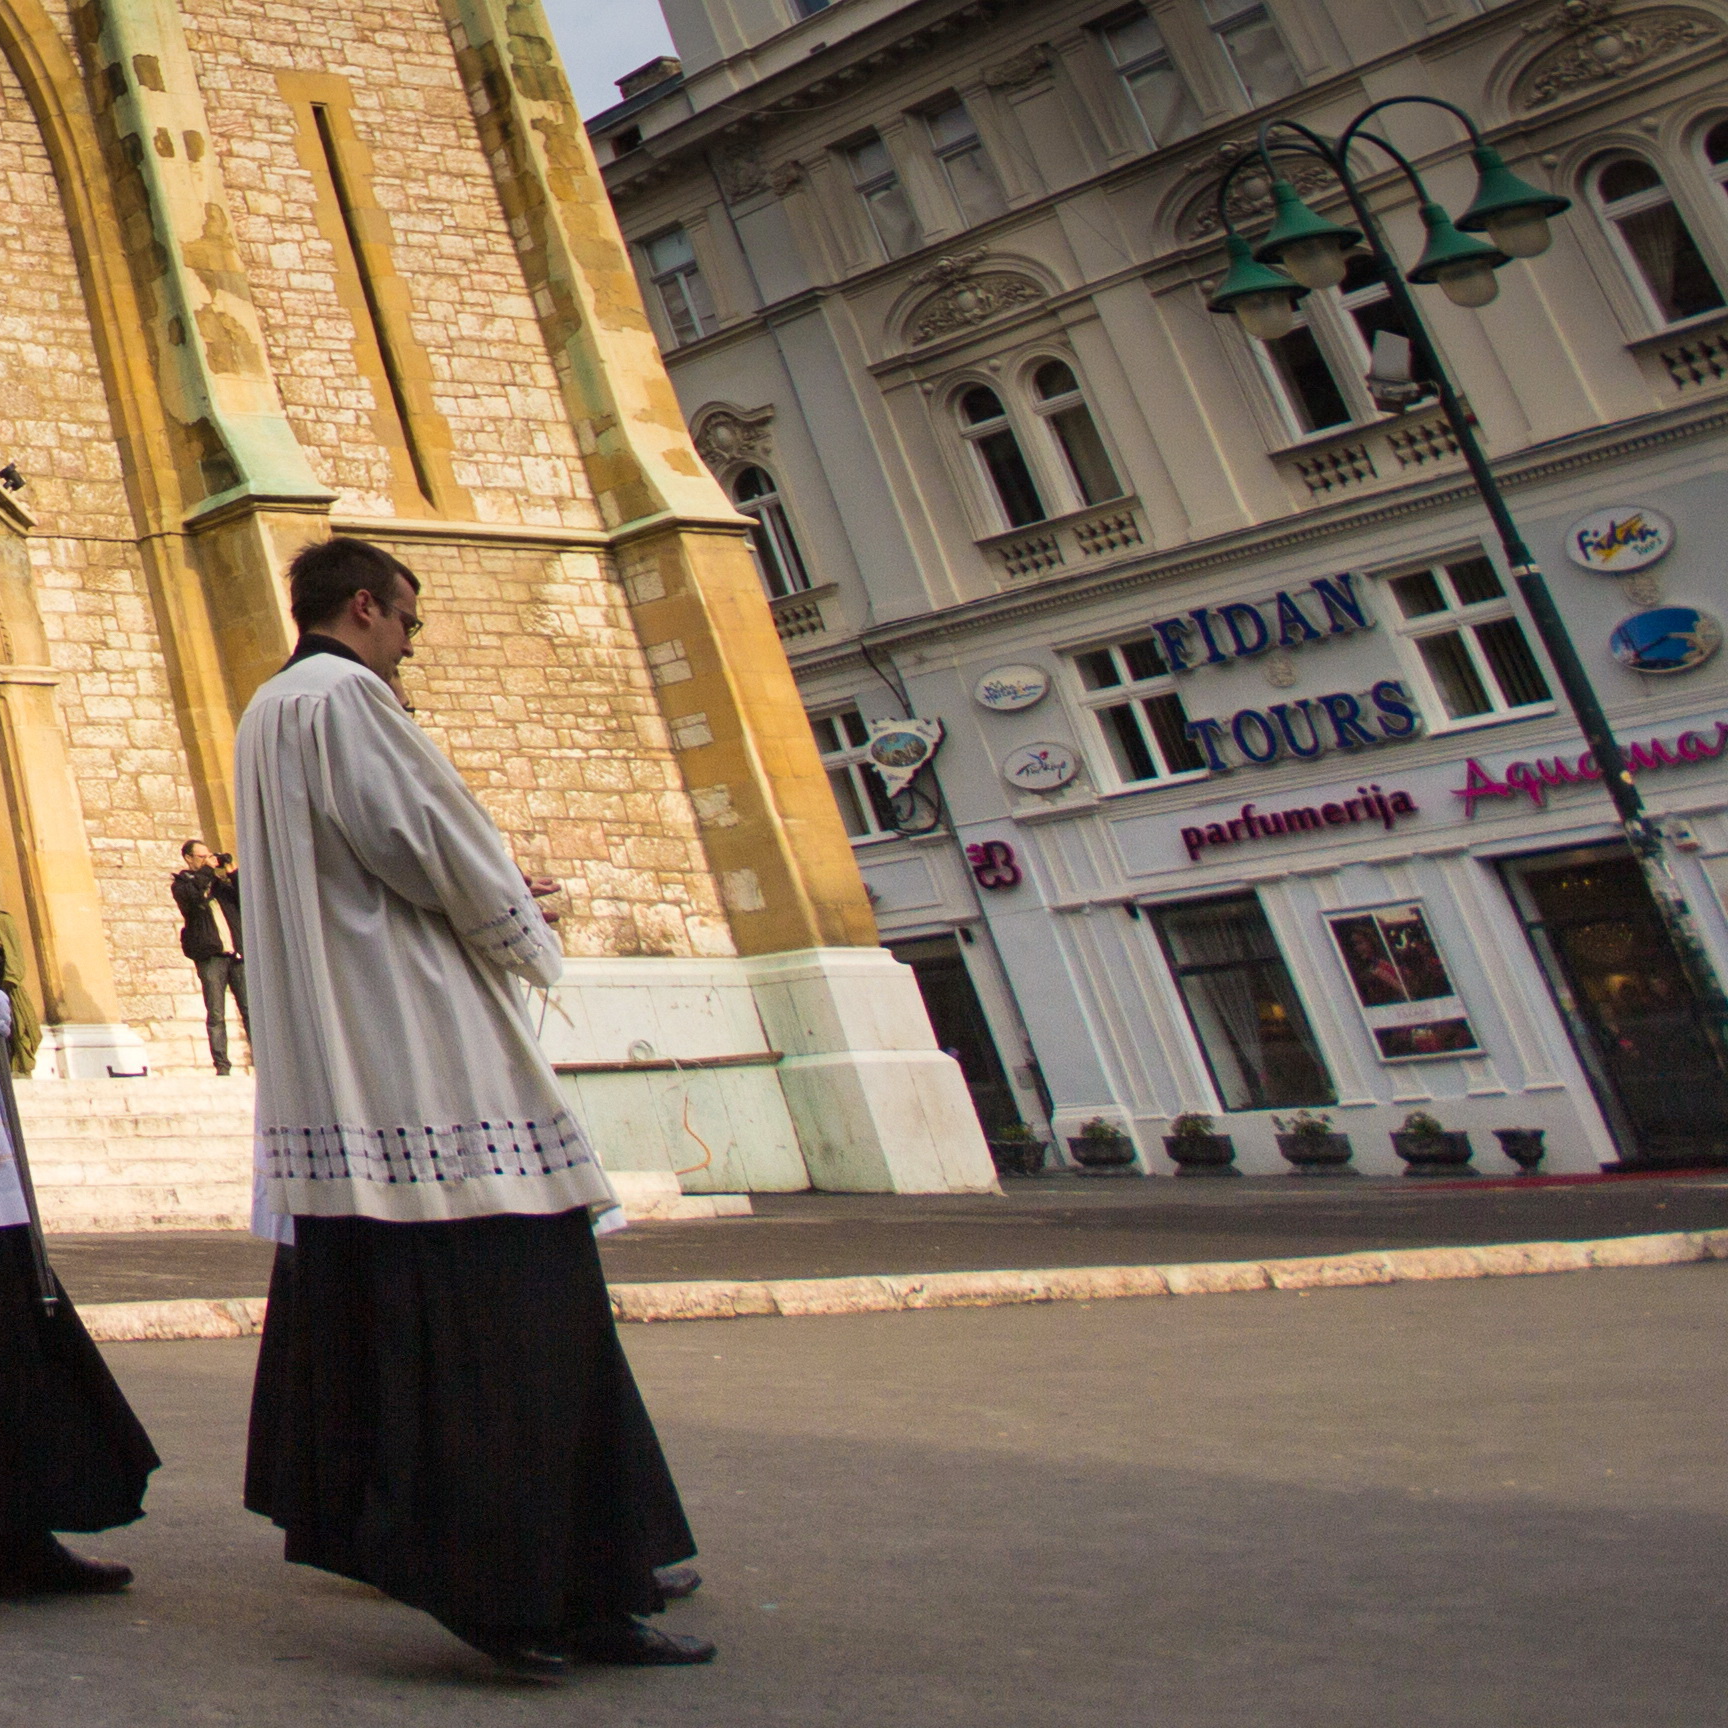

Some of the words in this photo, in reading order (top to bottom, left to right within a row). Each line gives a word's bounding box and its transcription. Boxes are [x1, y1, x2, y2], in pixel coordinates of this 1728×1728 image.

[1151, 573, 1368, 671] FIDAN
[1185, 680, 1417, 770] TOURS
[1181, 783, 1420, 861] parfumerija
